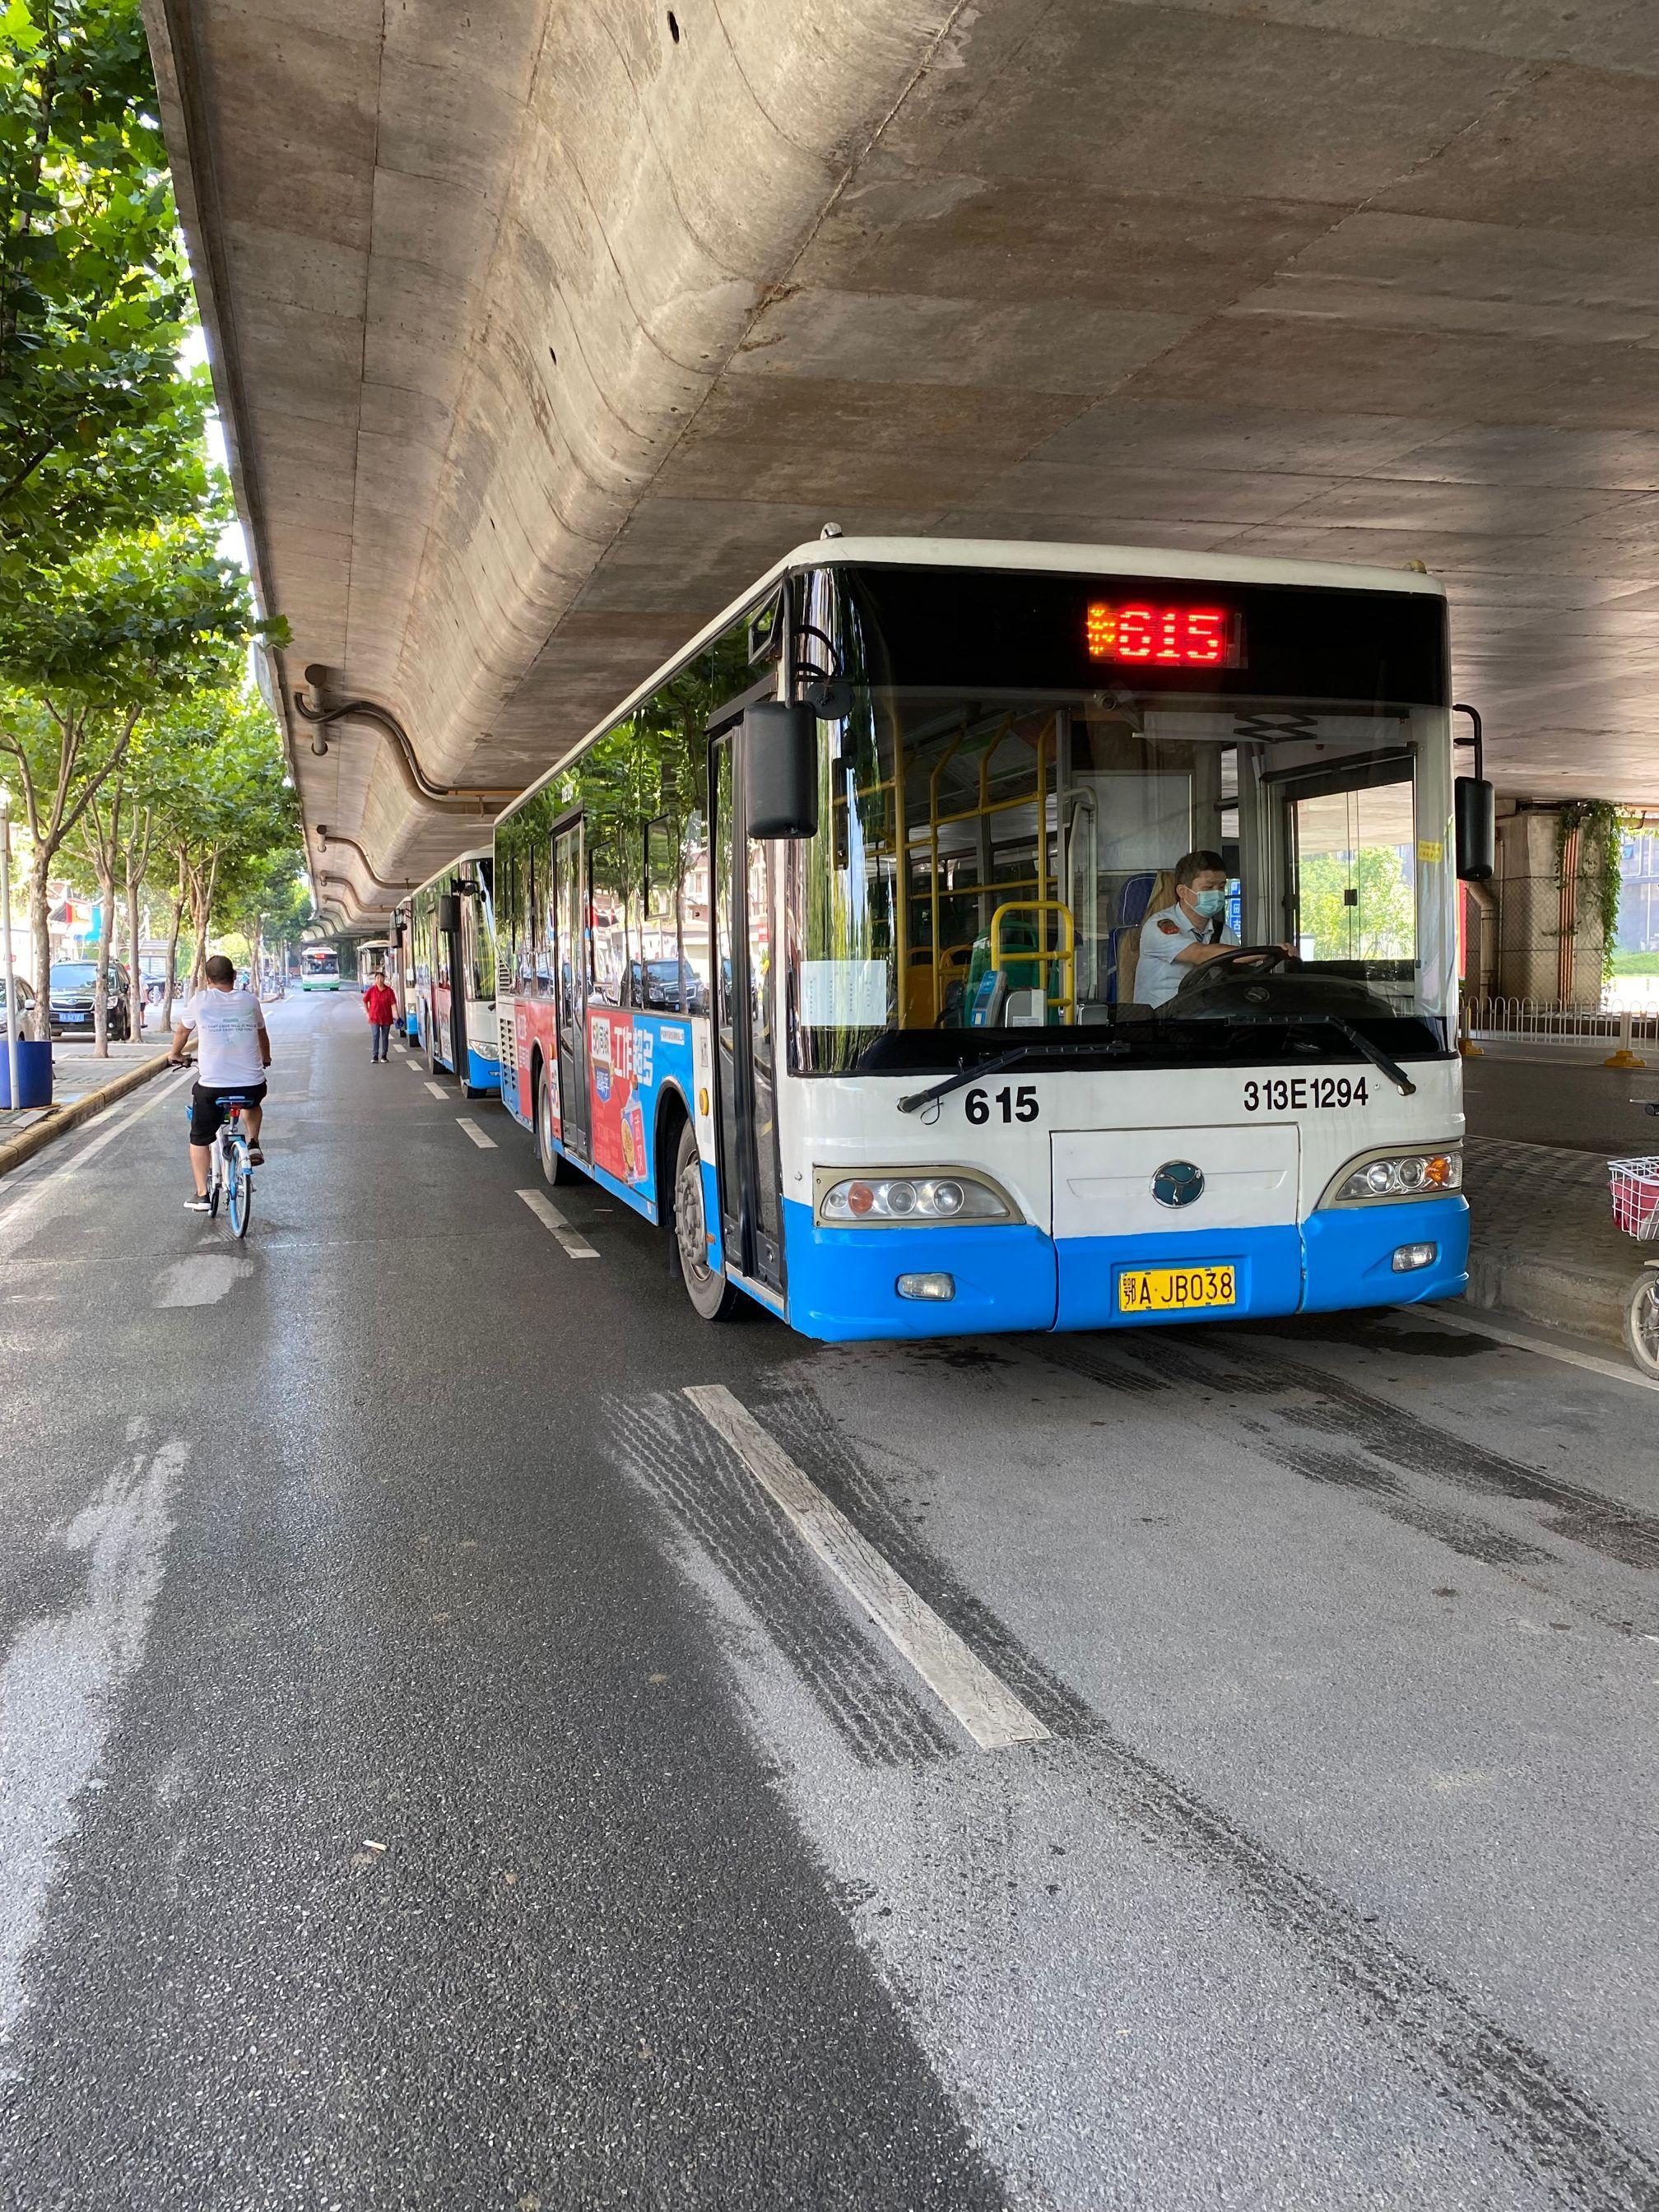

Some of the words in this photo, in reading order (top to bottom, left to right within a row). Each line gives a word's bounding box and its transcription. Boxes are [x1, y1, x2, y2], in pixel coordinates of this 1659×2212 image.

[1119, 610, 1220, 659] 615
[965, 1085, 1039, 1125] 615
[1243, 1076, 1369, 1111] 313E1294
